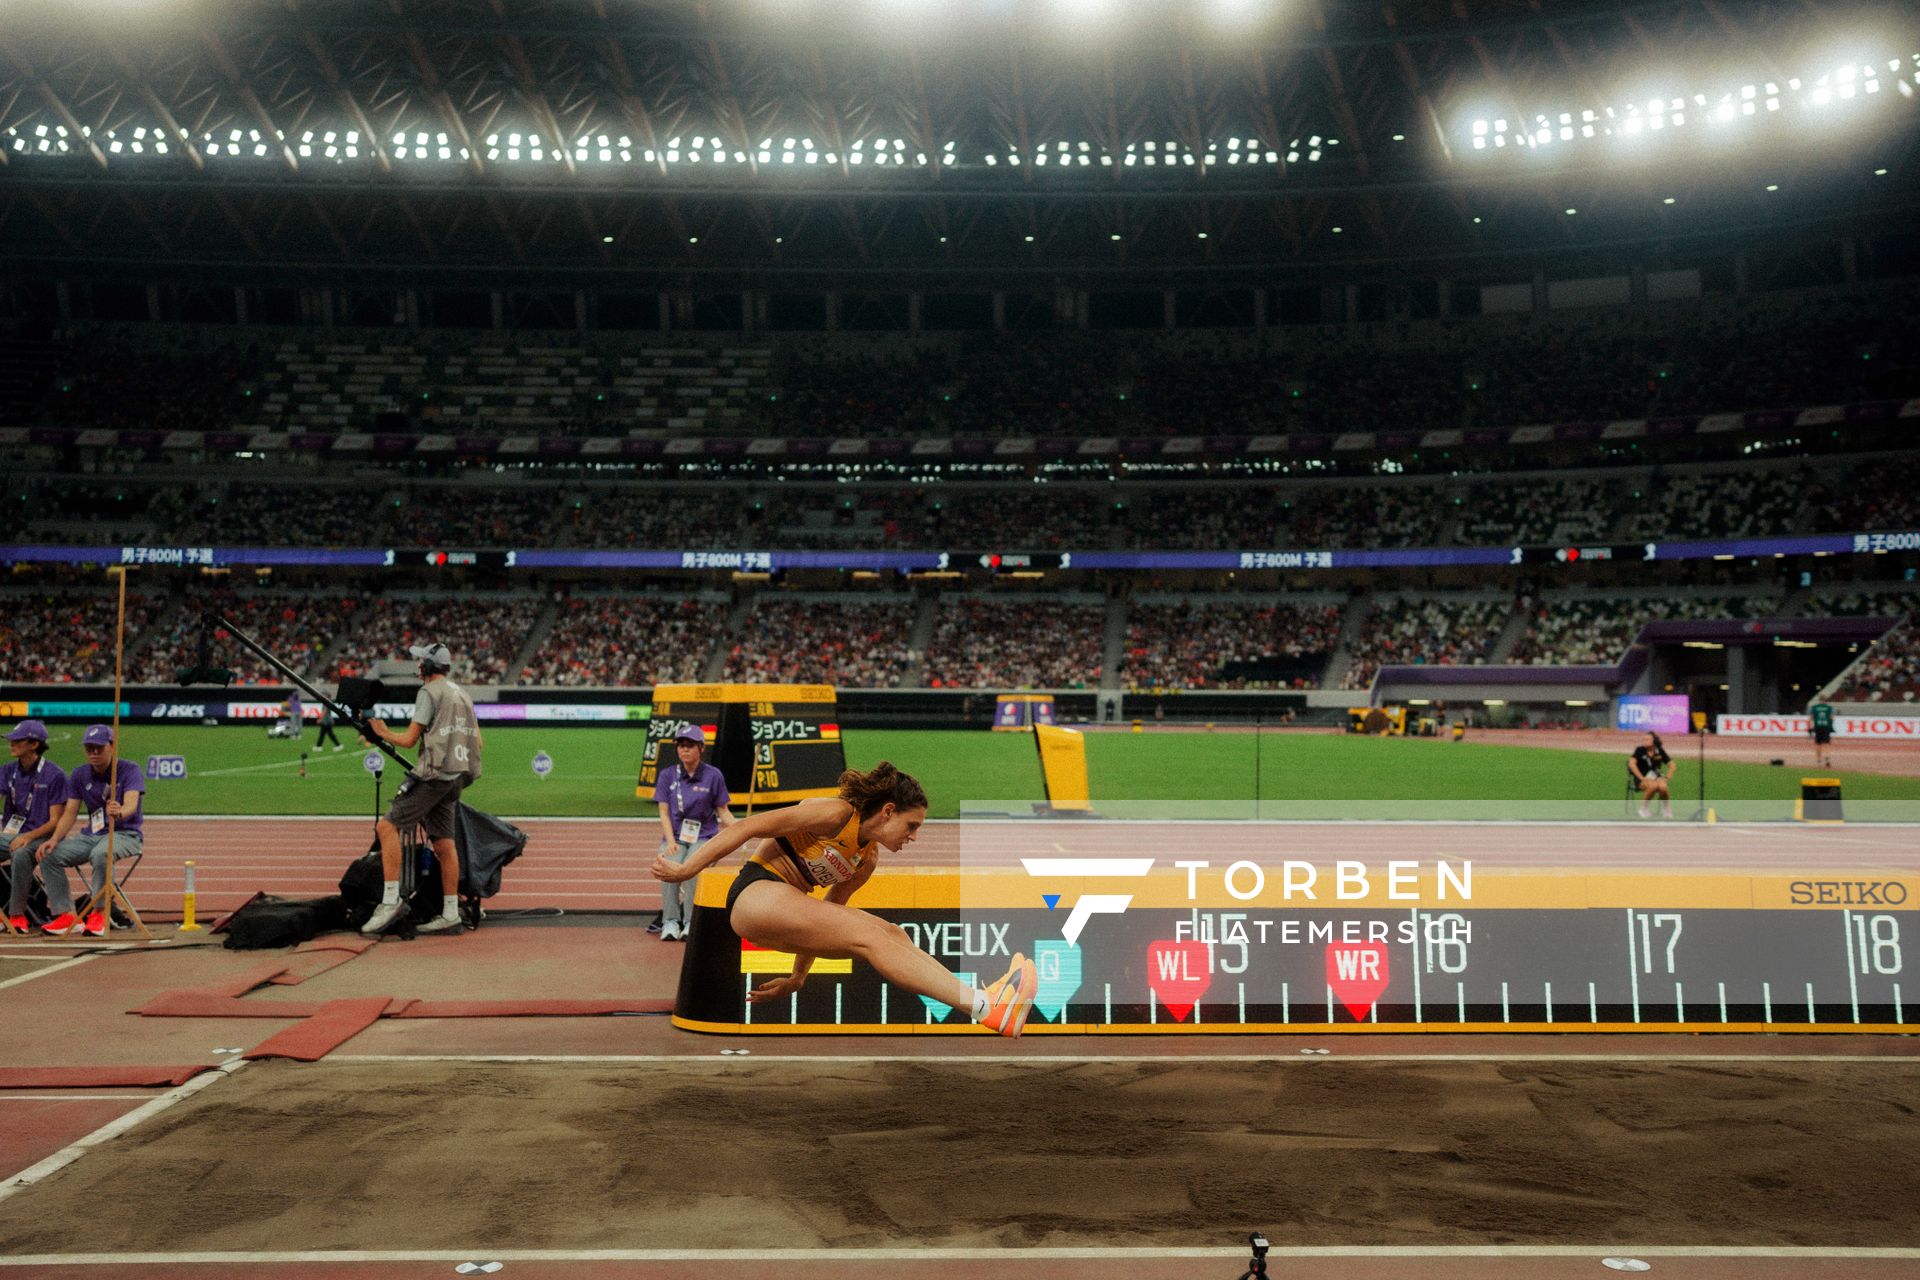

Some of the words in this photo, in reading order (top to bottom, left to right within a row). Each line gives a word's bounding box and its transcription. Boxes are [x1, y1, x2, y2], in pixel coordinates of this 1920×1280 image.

[233, 706, 321, 718] HONA
[1724, 719, 1811, 732] HOND
[1846, 719, 1920, 734] HON
[159, 760, 184, 777] 80
[825, 850, 852, 880] HONDA
[1790, 881, 1908, 905] SEIKO
[898, 922, 1011, 957] OYEUX
[1201, 913, 1249, 974] 15
[1420, 913, 1468, 974] 16
[1636, 913, 1683, 974] 17
[1853, 914, 1903, 975] 18
[1040, 949, 1060, 981] Q
[1156, 949, 1201, 981] WL
[1335, 949, 1380, 981] WR
